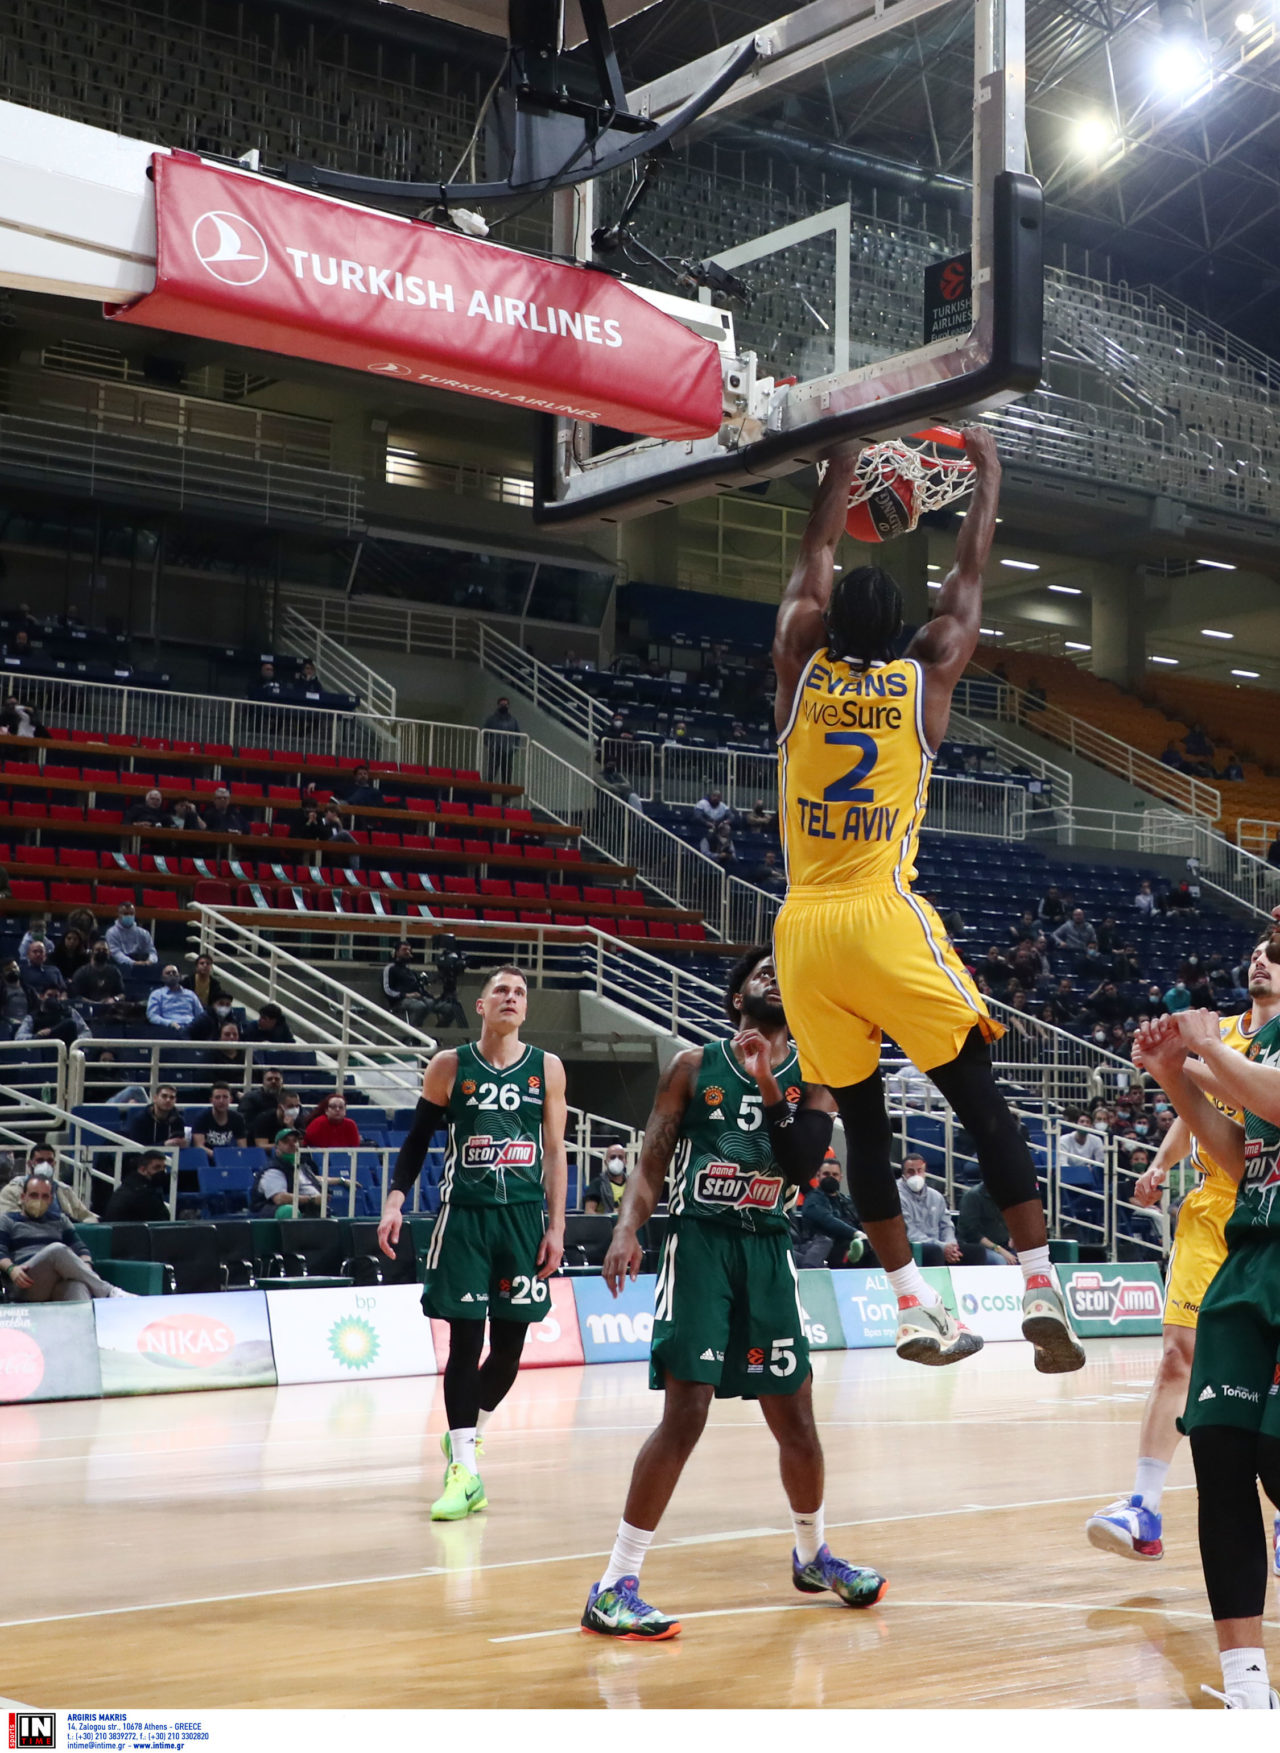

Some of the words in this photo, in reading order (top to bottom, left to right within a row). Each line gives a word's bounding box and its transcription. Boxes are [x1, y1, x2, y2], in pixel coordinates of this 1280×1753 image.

[286, 246, 455, 313] TURKISH
[467, 290, 623, 348] AIRLINES
[933, 297, 972, 319] TURKISH
[932, 310, 972, 332] AIRLINES
[417, 373, 508, 398] TURKISH
[509, 394, 602, 420] AIRLINES
[805, 663, 908, 697] EVANS
[804, 700, 902, 729] weSure
[823, 732, 879, 803] 2
[797, 797, 836, 840] TEL
[842, 807, 900, 841] AVIV
[478, 1082, 520, 1110] 26
[736, 1095, 763, 1131] 5
[356, 1294, 376, 1312] bp
[511, 1275, 547, 1304] 26
[146, 1327, 230, 1355] NIKAS
[769, 1338, 797, 1377] 5
[1221, 1384, 1259, 1403] Tonovit
